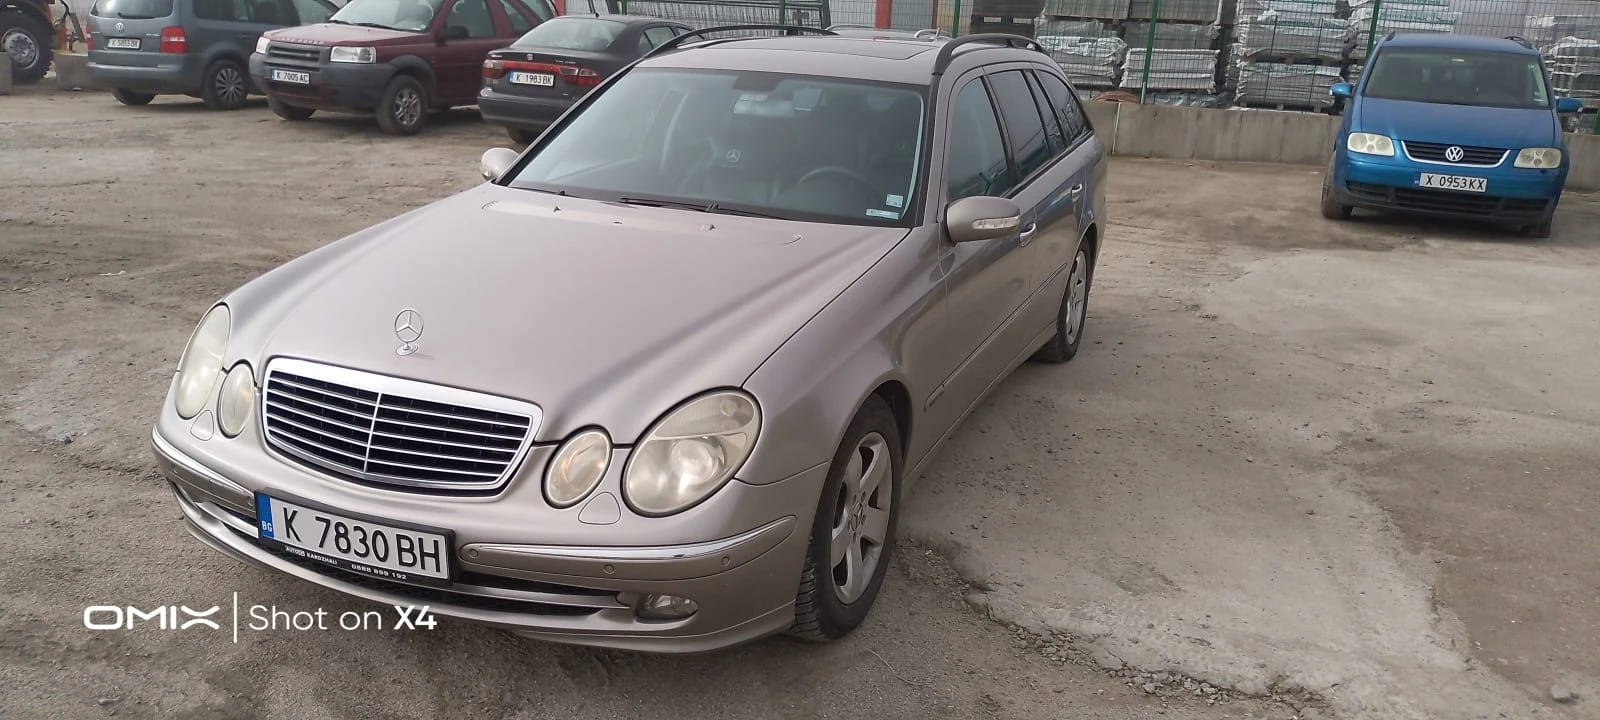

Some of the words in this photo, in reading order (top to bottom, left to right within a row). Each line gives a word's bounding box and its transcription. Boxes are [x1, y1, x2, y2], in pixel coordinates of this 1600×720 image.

[284, 72, 299, 81] 7005
[300, 74, 308, 82] AC
[525, 75, 541, 84] 1983
[542, 76, 552, 85] BK
[1426, 175, 1434, 185] X
[1439, 176, 1467, 188] 0953
[1468, 179, 1485, 191] KX
[261, 520, 273, 532] BG
[283, 507, 301, 542] K
[315, 516, 389, 562] 7830
[396, 534, 440, 572] BH
[392, 572, 408, 580] 192
